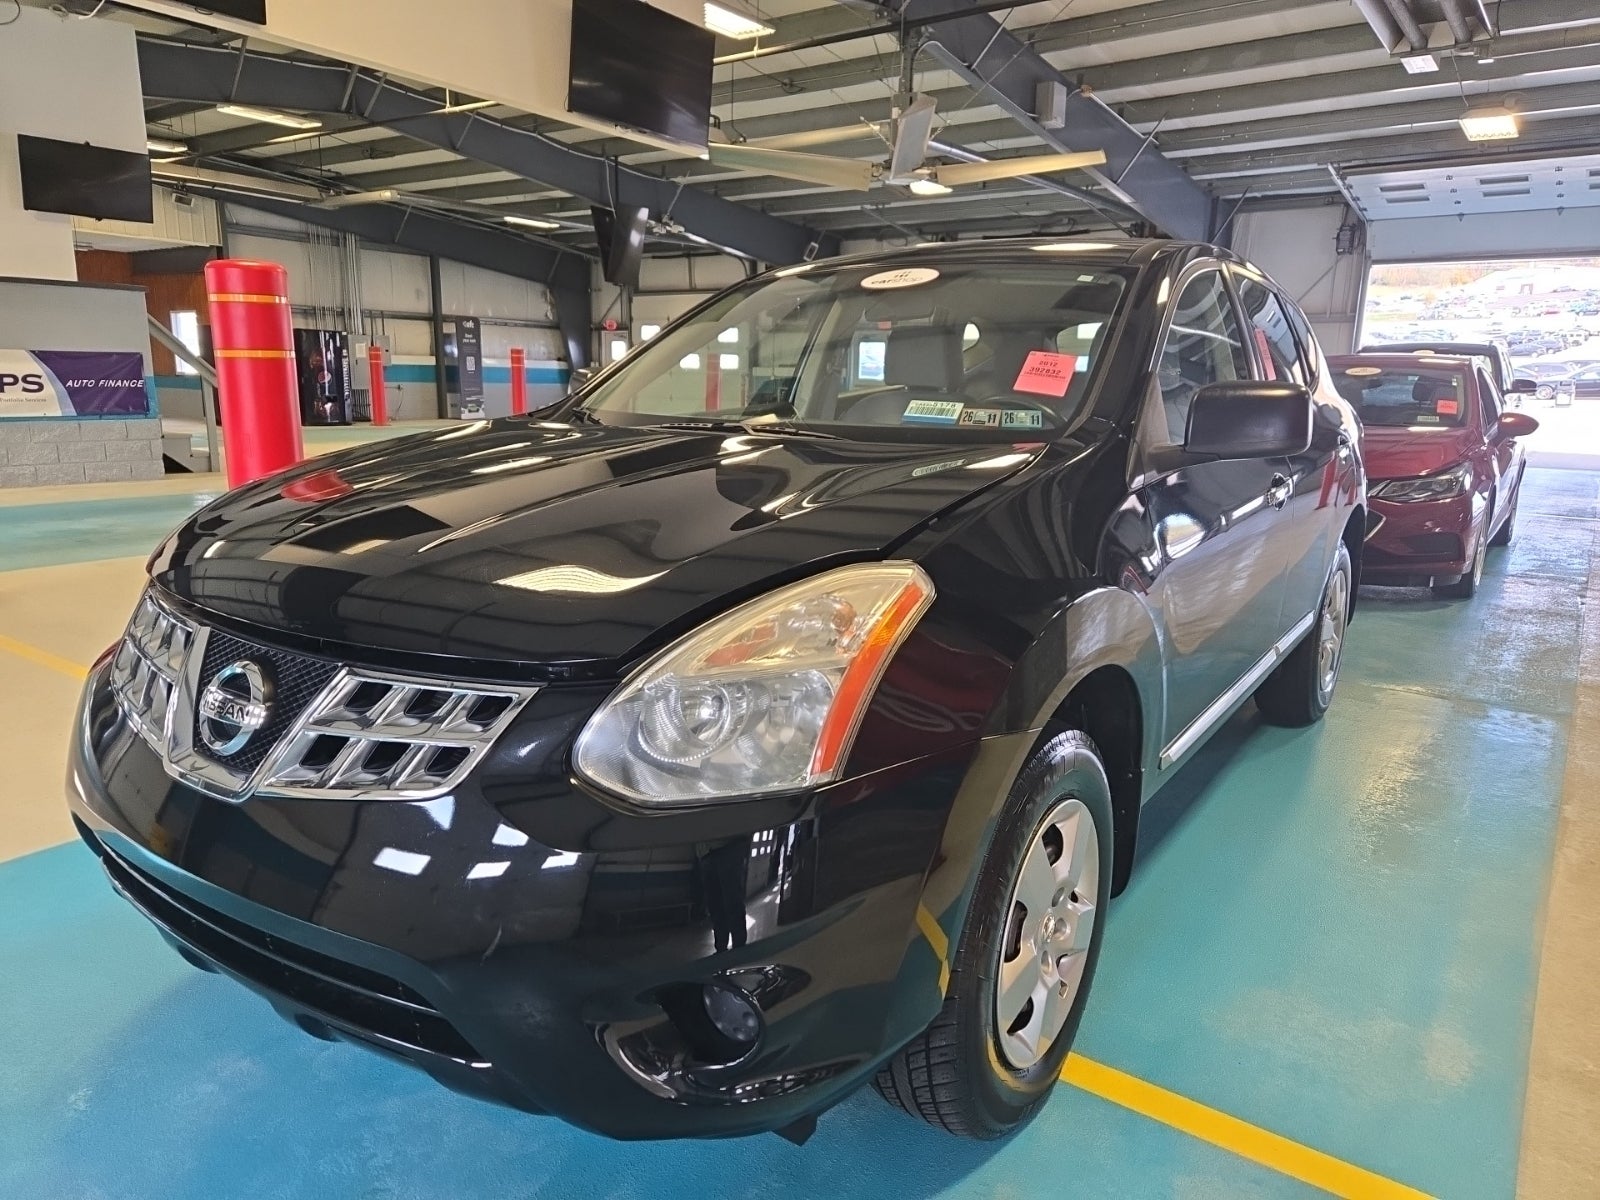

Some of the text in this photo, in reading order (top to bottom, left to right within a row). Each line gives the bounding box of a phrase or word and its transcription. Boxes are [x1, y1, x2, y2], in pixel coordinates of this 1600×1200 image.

[66, 379, 144, 388] AUTO FINANCE
[963, 410, 997, 424] 26 11
[1004, 410, 1040, 425] 26 11
